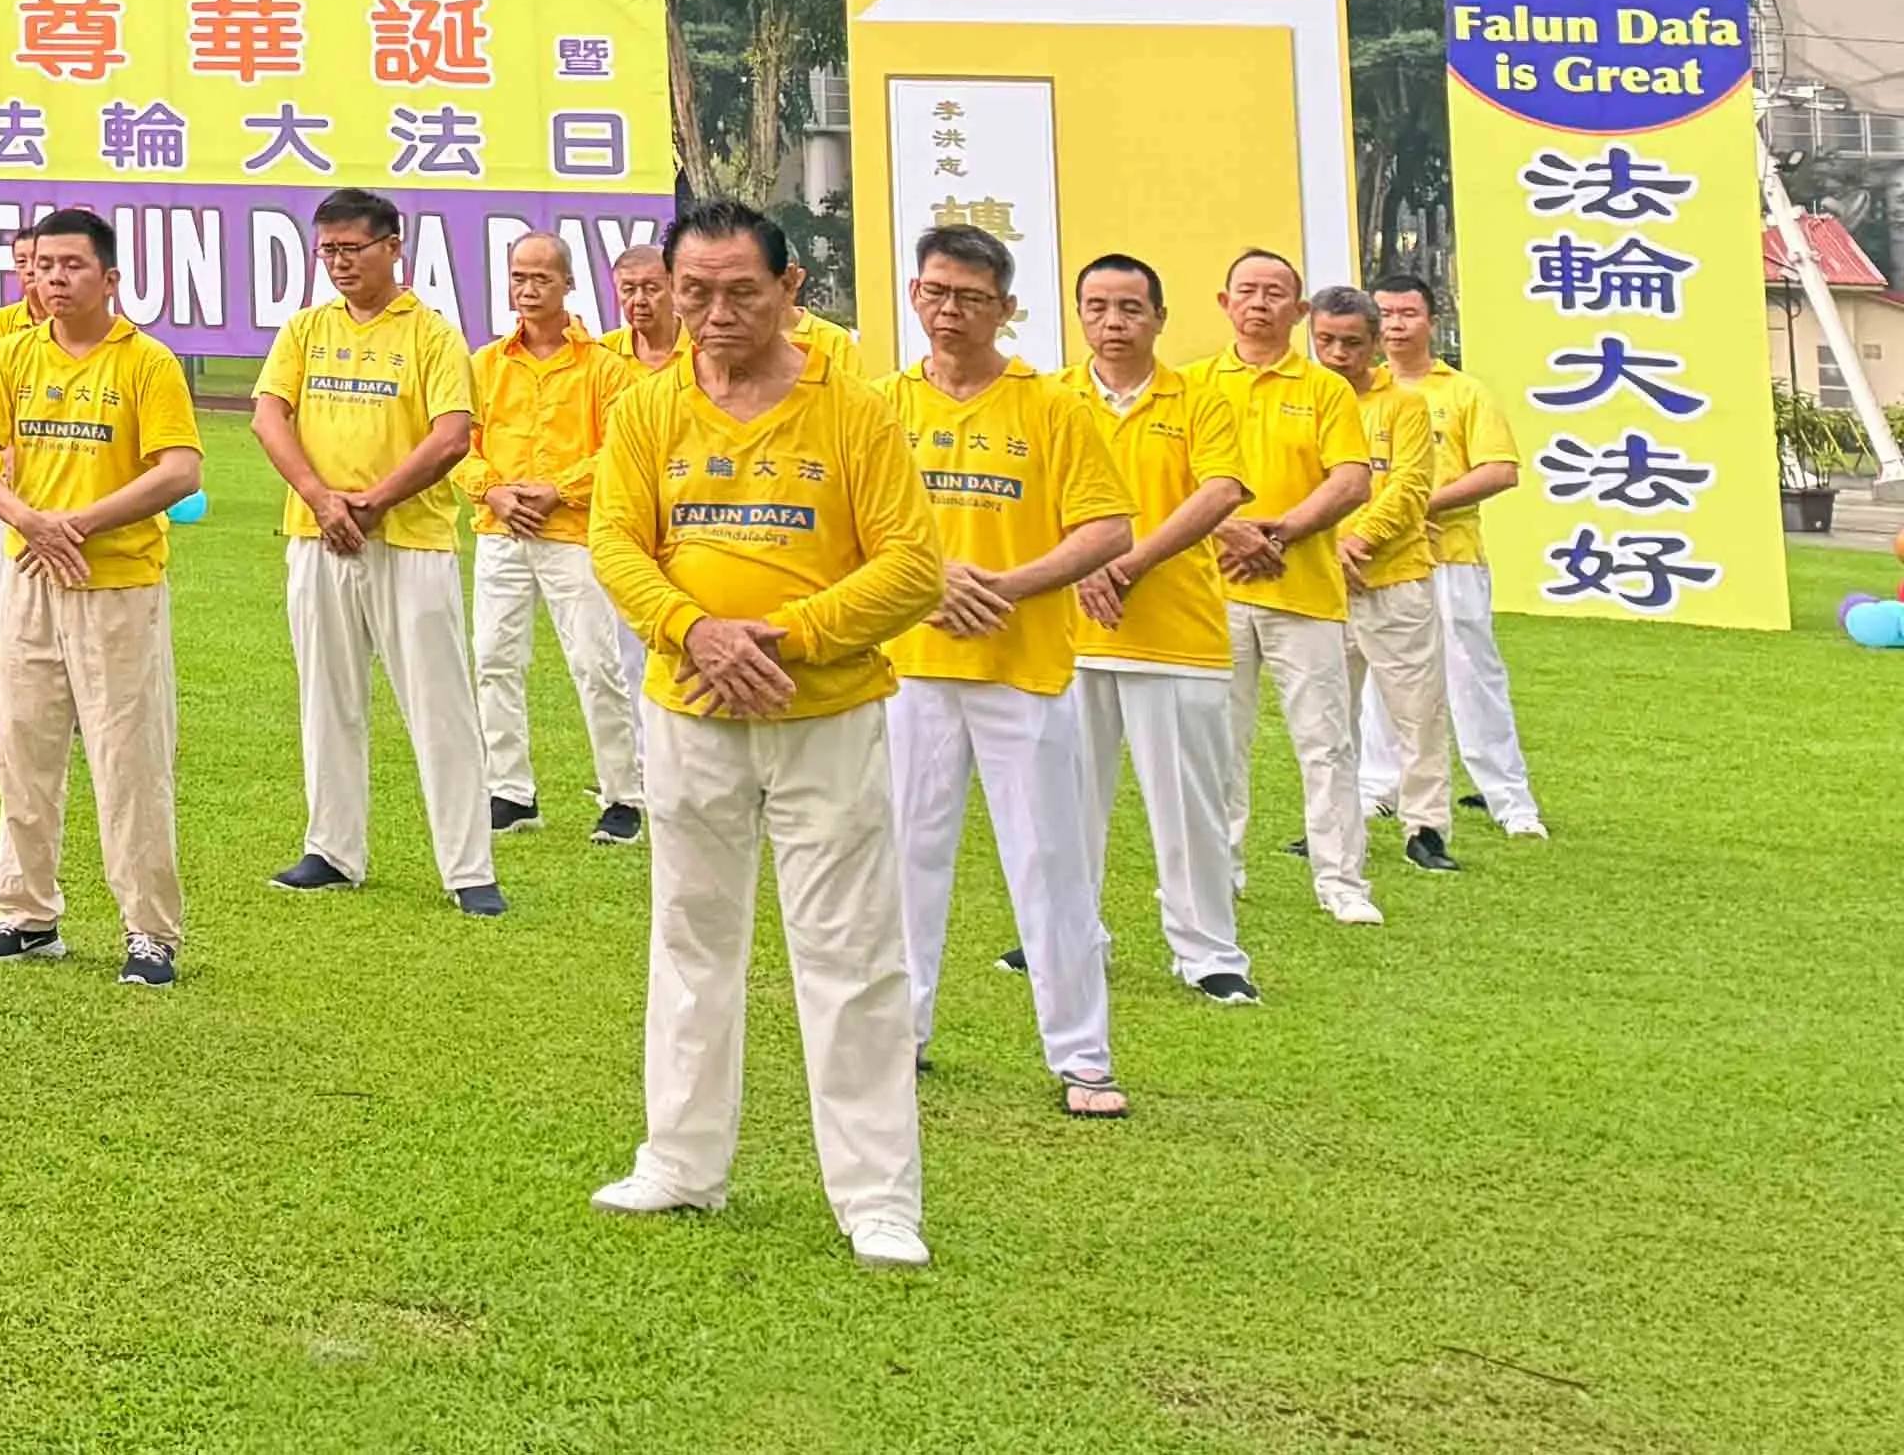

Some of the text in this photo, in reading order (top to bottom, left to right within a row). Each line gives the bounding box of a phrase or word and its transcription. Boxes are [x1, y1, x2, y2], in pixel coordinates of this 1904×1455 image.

[1454, 6, 1741, 47] Falun Dafa
[1495, 54, 1704, 96] is Great
[1524, 148, 1716, 608] 法輪大法好
[967, 476, 1016, 496] DAFA
[674, 506, 807, 526] FALUN DAFA
